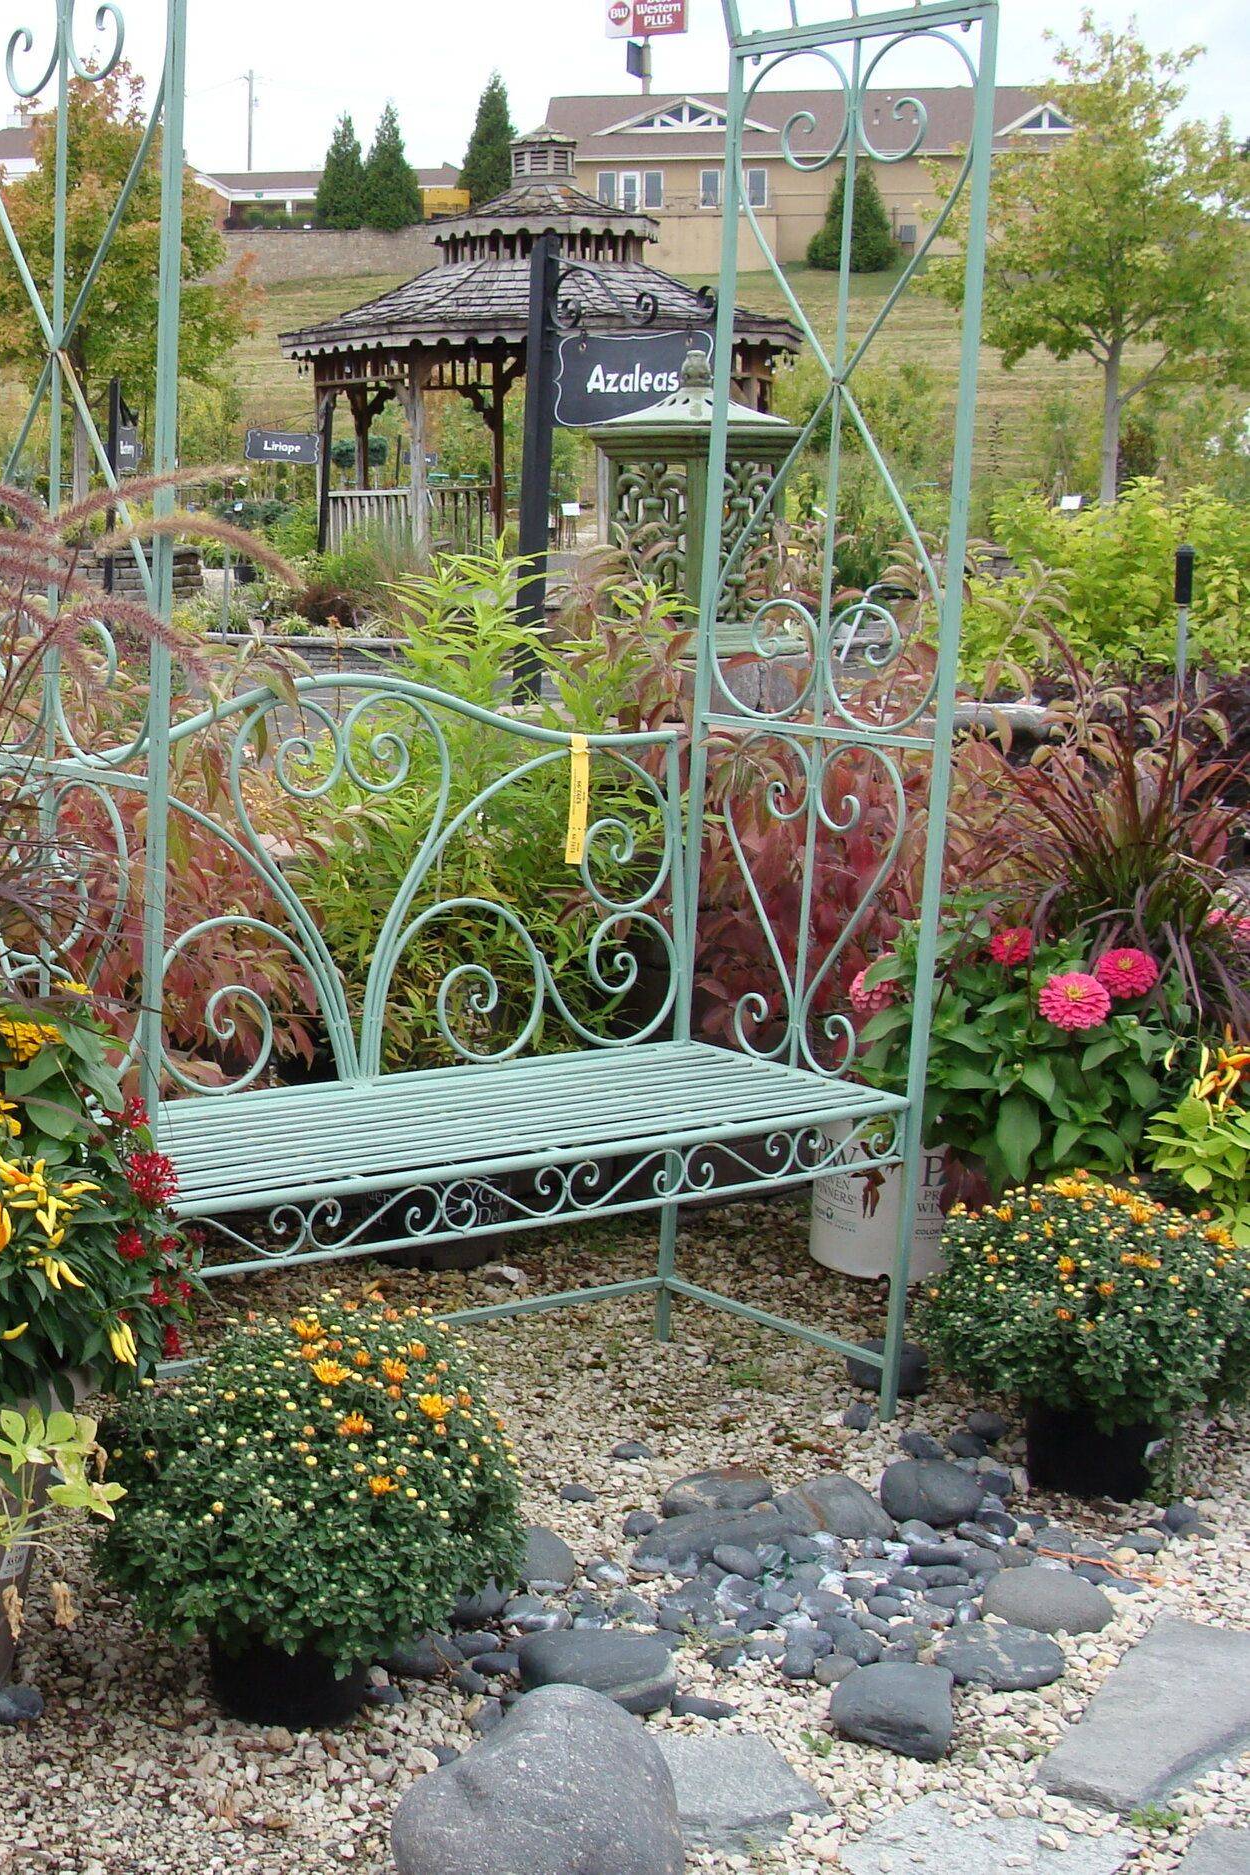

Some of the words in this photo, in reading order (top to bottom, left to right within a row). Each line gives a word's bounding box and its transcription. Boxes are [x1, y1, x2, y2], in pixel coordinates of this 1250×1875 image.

[610, 7, 629, 19] BW
[636, 2, 681, 15] Western
[643, 14, 673, 26] PLUS
[586, 362, 680, 394] Azaleas
[263, 440, 301, 455] Liriope
